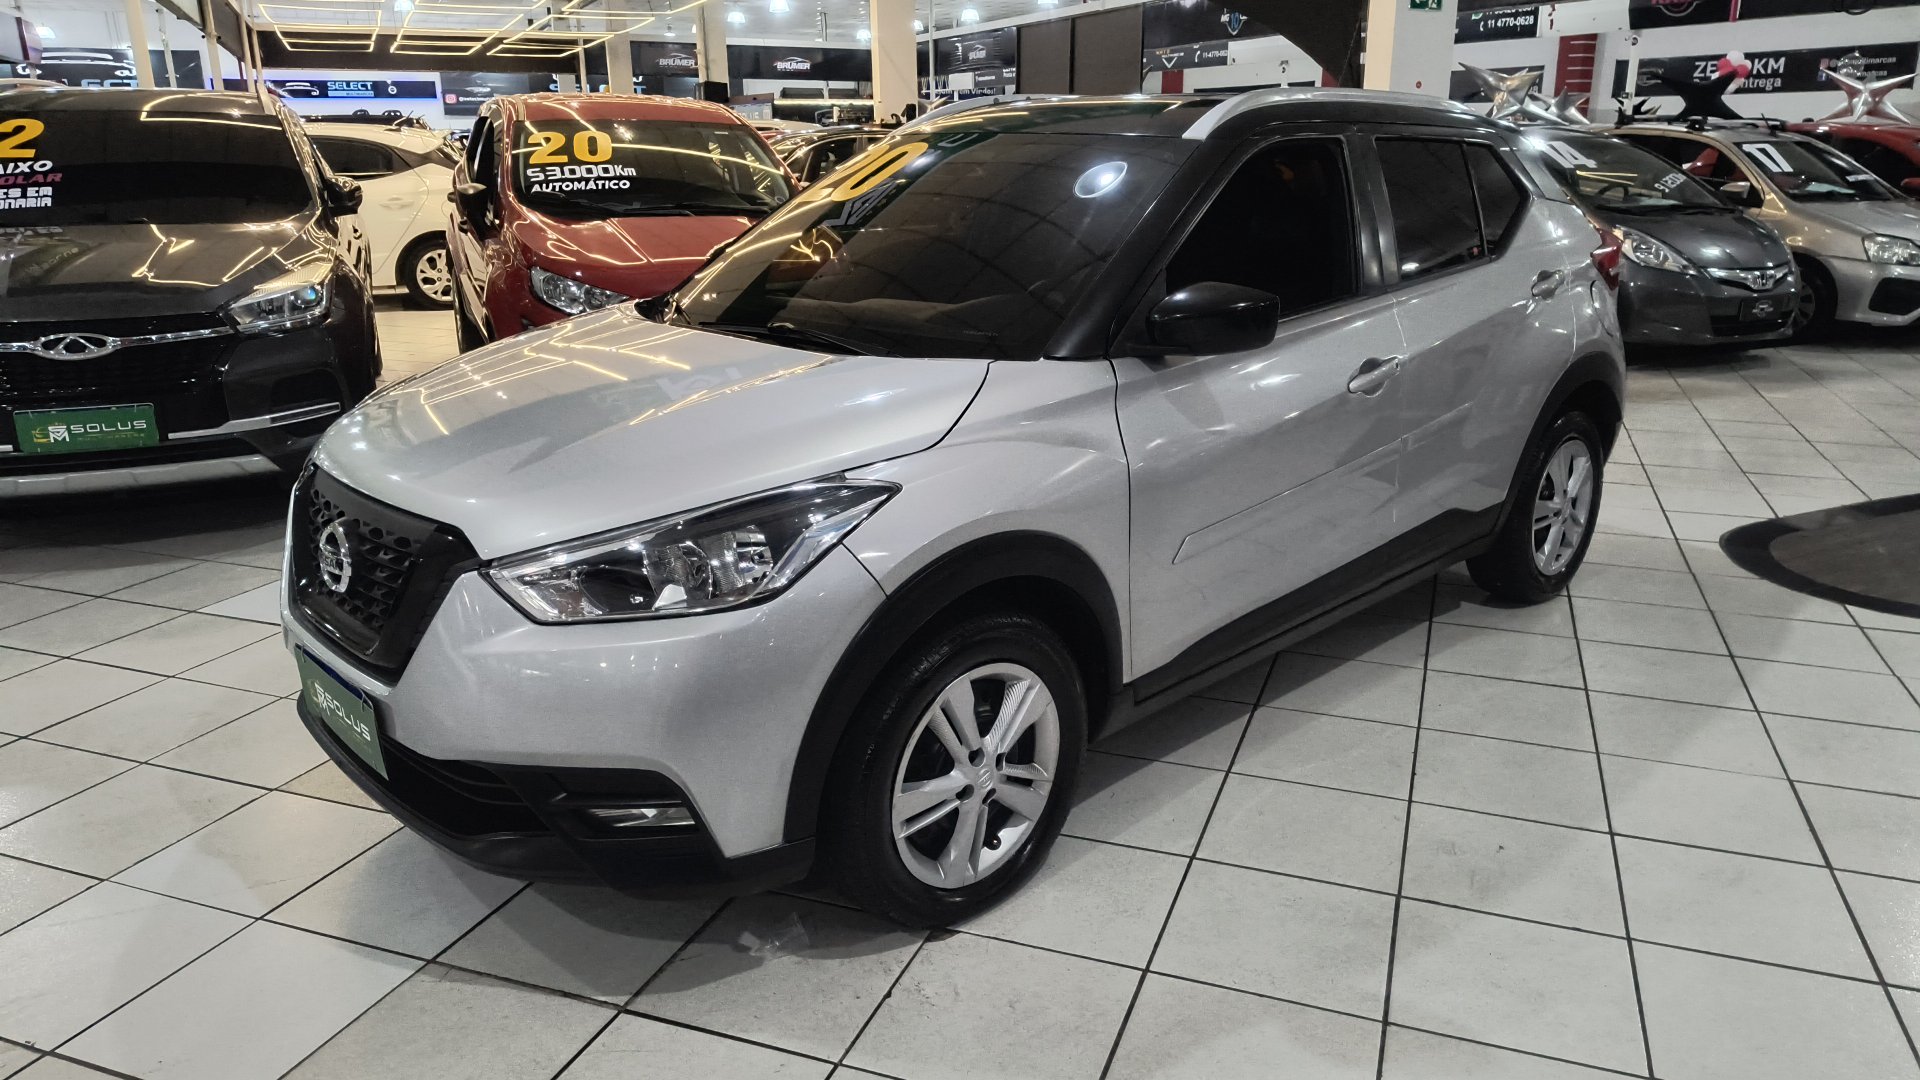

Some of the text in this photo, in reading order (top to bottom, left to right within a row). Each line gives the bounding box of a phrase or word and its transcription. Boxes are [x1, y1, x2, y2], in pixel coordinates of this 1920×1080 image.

[1497, 15, 1534, 27] 4770-0628
[327, 82, 373, 90] SELECT
[1738, 75, 1782, 91] ntrega
[527, 130, 613, 164] 20
[26, 186, 53, 197] EM
[531, 178, 631, 194] AUTOMÁTICO
[70, 420, 147, 434] SOLUS
[325, 691, 371, 742] SOLUS
